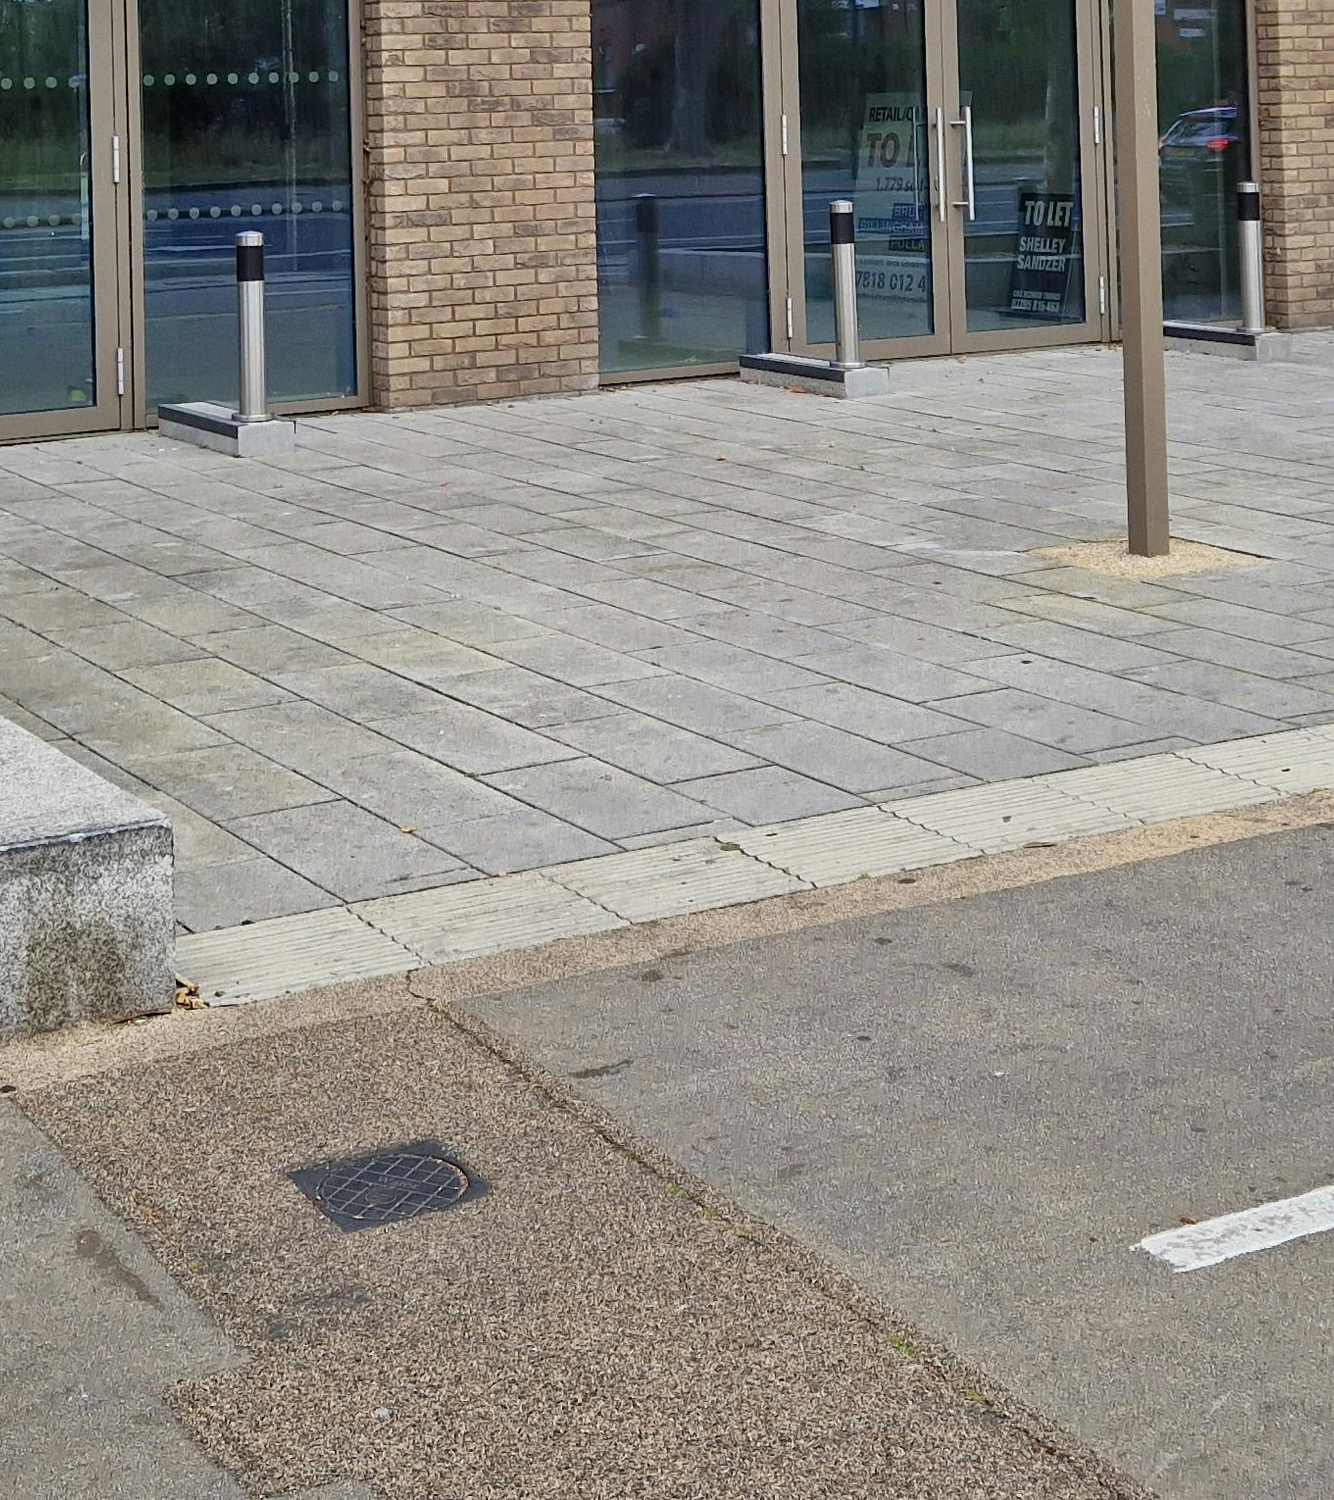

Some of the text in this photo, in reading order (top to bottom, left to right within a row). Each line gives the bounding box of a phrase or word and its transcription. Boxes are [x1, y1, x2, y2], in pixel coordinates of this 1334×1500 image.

[866, 132, 900, 168] TO
[1024, 201, 1074, 227] TO LET
[1019, 236, 1066, 253] SHELLEY
[1016, 254, 1066, 272] SANDZER
